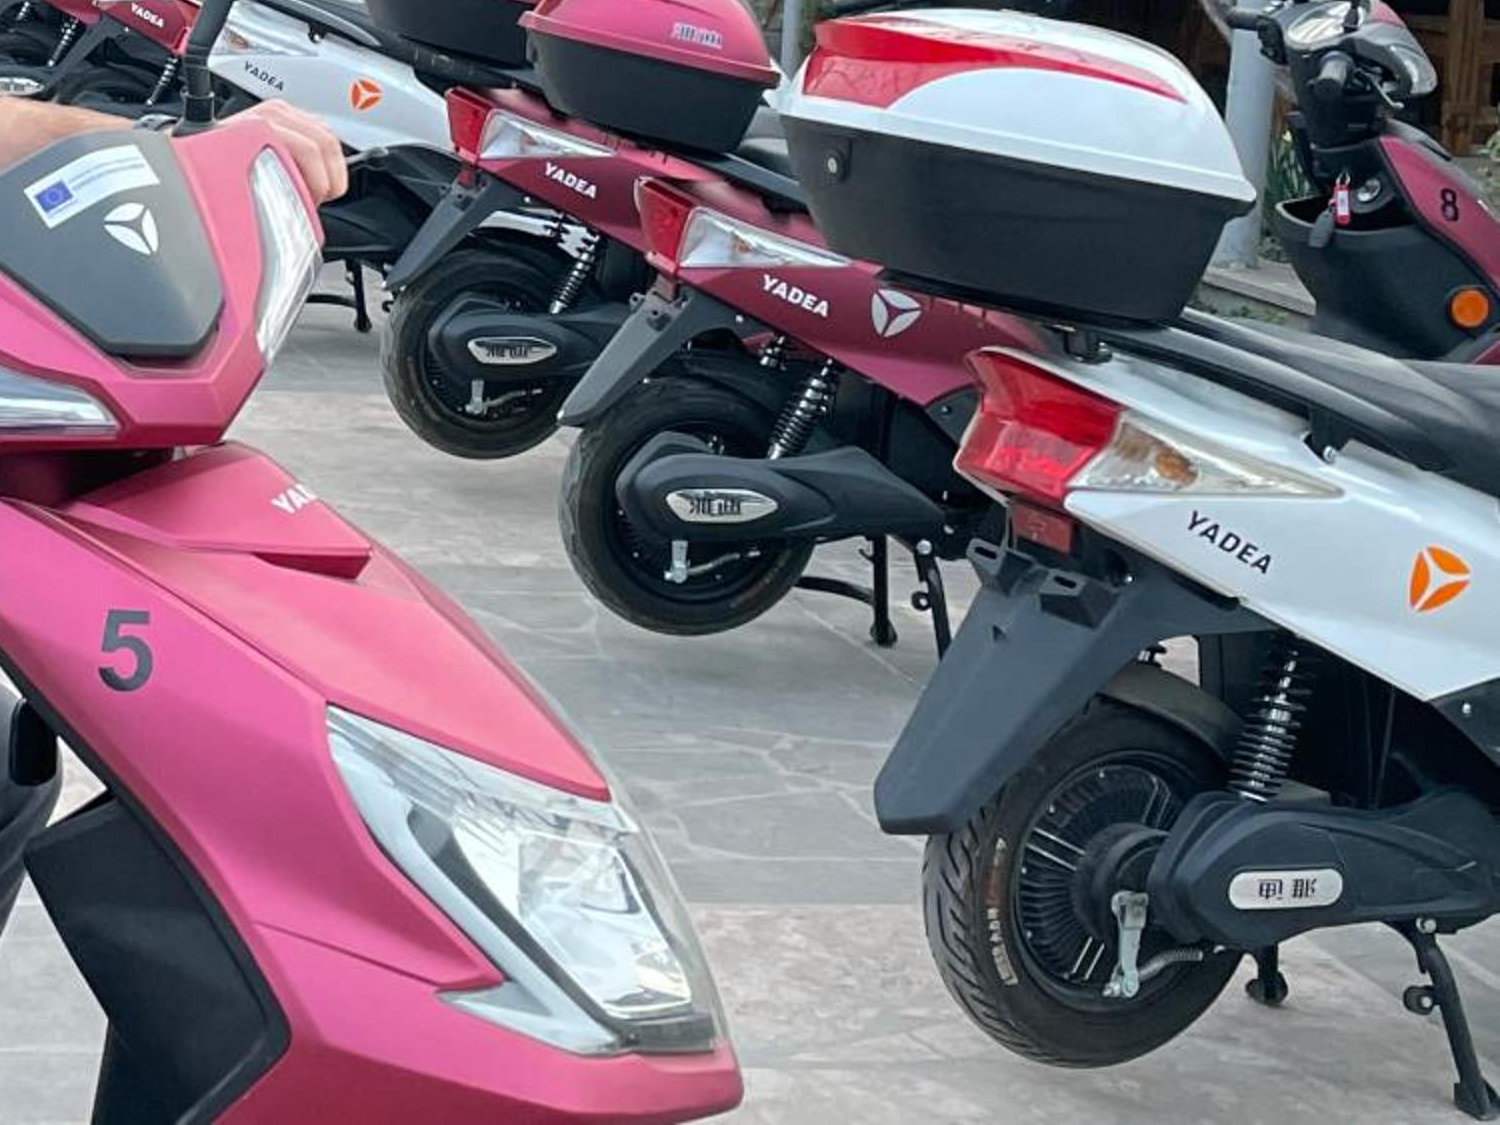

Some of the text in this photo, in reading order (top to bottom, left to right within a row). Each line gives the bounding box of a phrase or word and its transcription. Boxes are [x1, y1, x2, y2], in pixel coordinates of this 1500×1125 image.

[131, 2, 165, 28] YADEA
[245, 61, 284, 91] YADEA
[545, 161, 597, 199] YADEA
[1440, 188, 1459, 222] 8
[763, 274, 829, 318] YADEA
[1187, 509, 1272, 574] YADEA
[98, 609, 153, 692] 5
